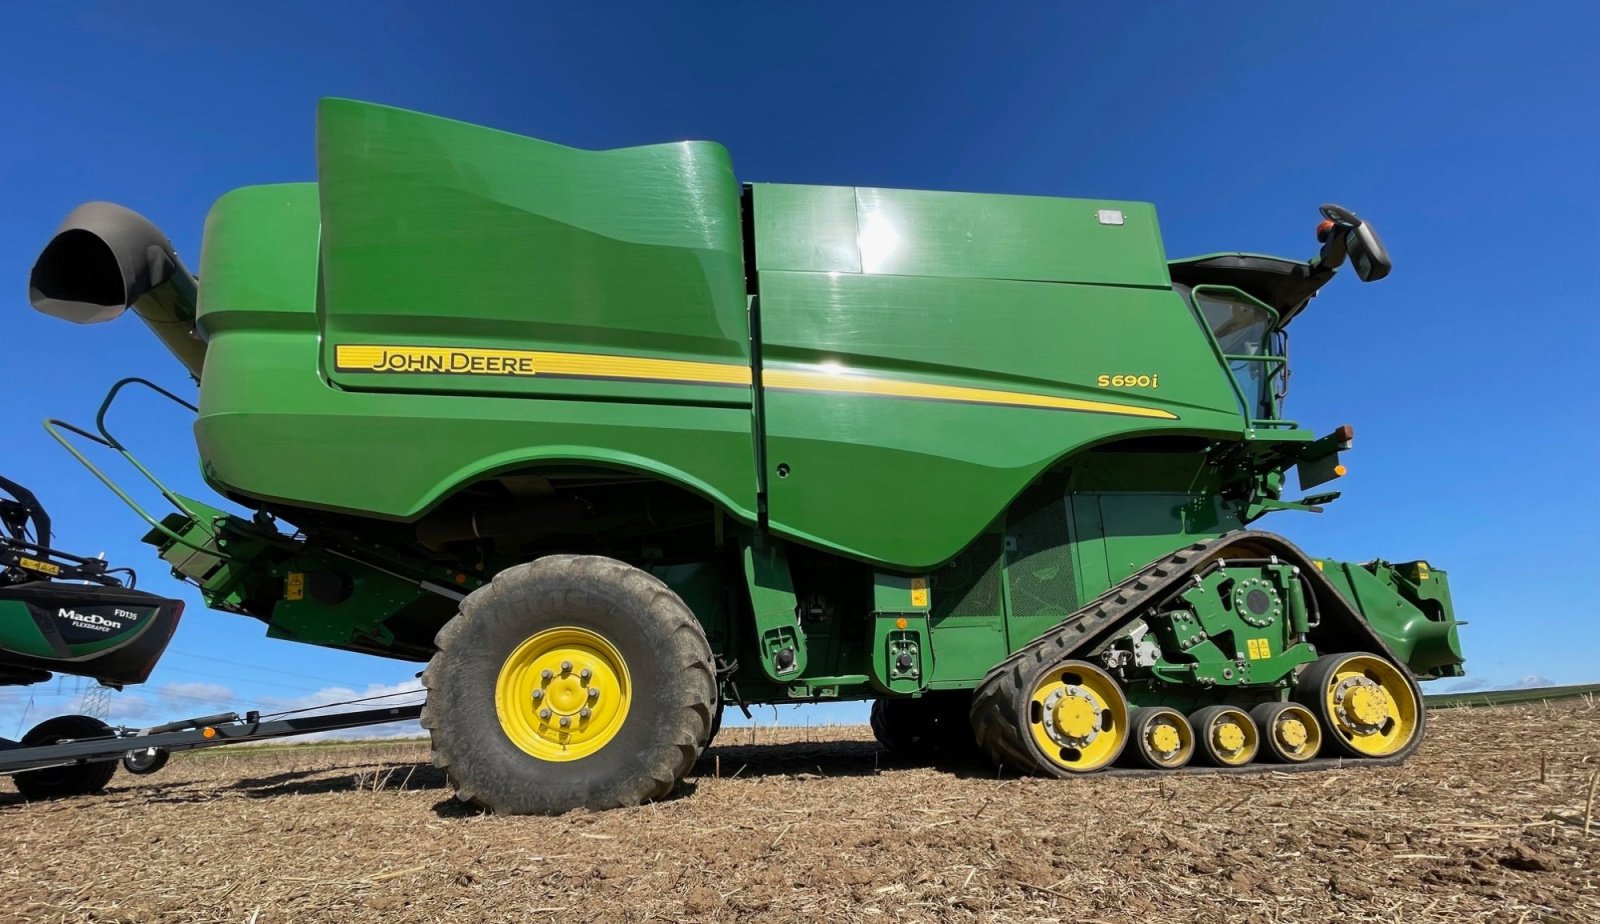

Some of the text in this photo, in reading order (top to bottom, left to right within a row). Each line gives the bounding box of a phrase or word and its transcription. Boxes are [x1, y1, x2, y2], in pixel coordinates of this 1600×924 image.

[373, 350, 533, 373] JOHN DEERE
[1097, 373, 1159, 388] S690i
[58, 608, 121, 628] MacDon
[114, 609, 138, 620] FD135
